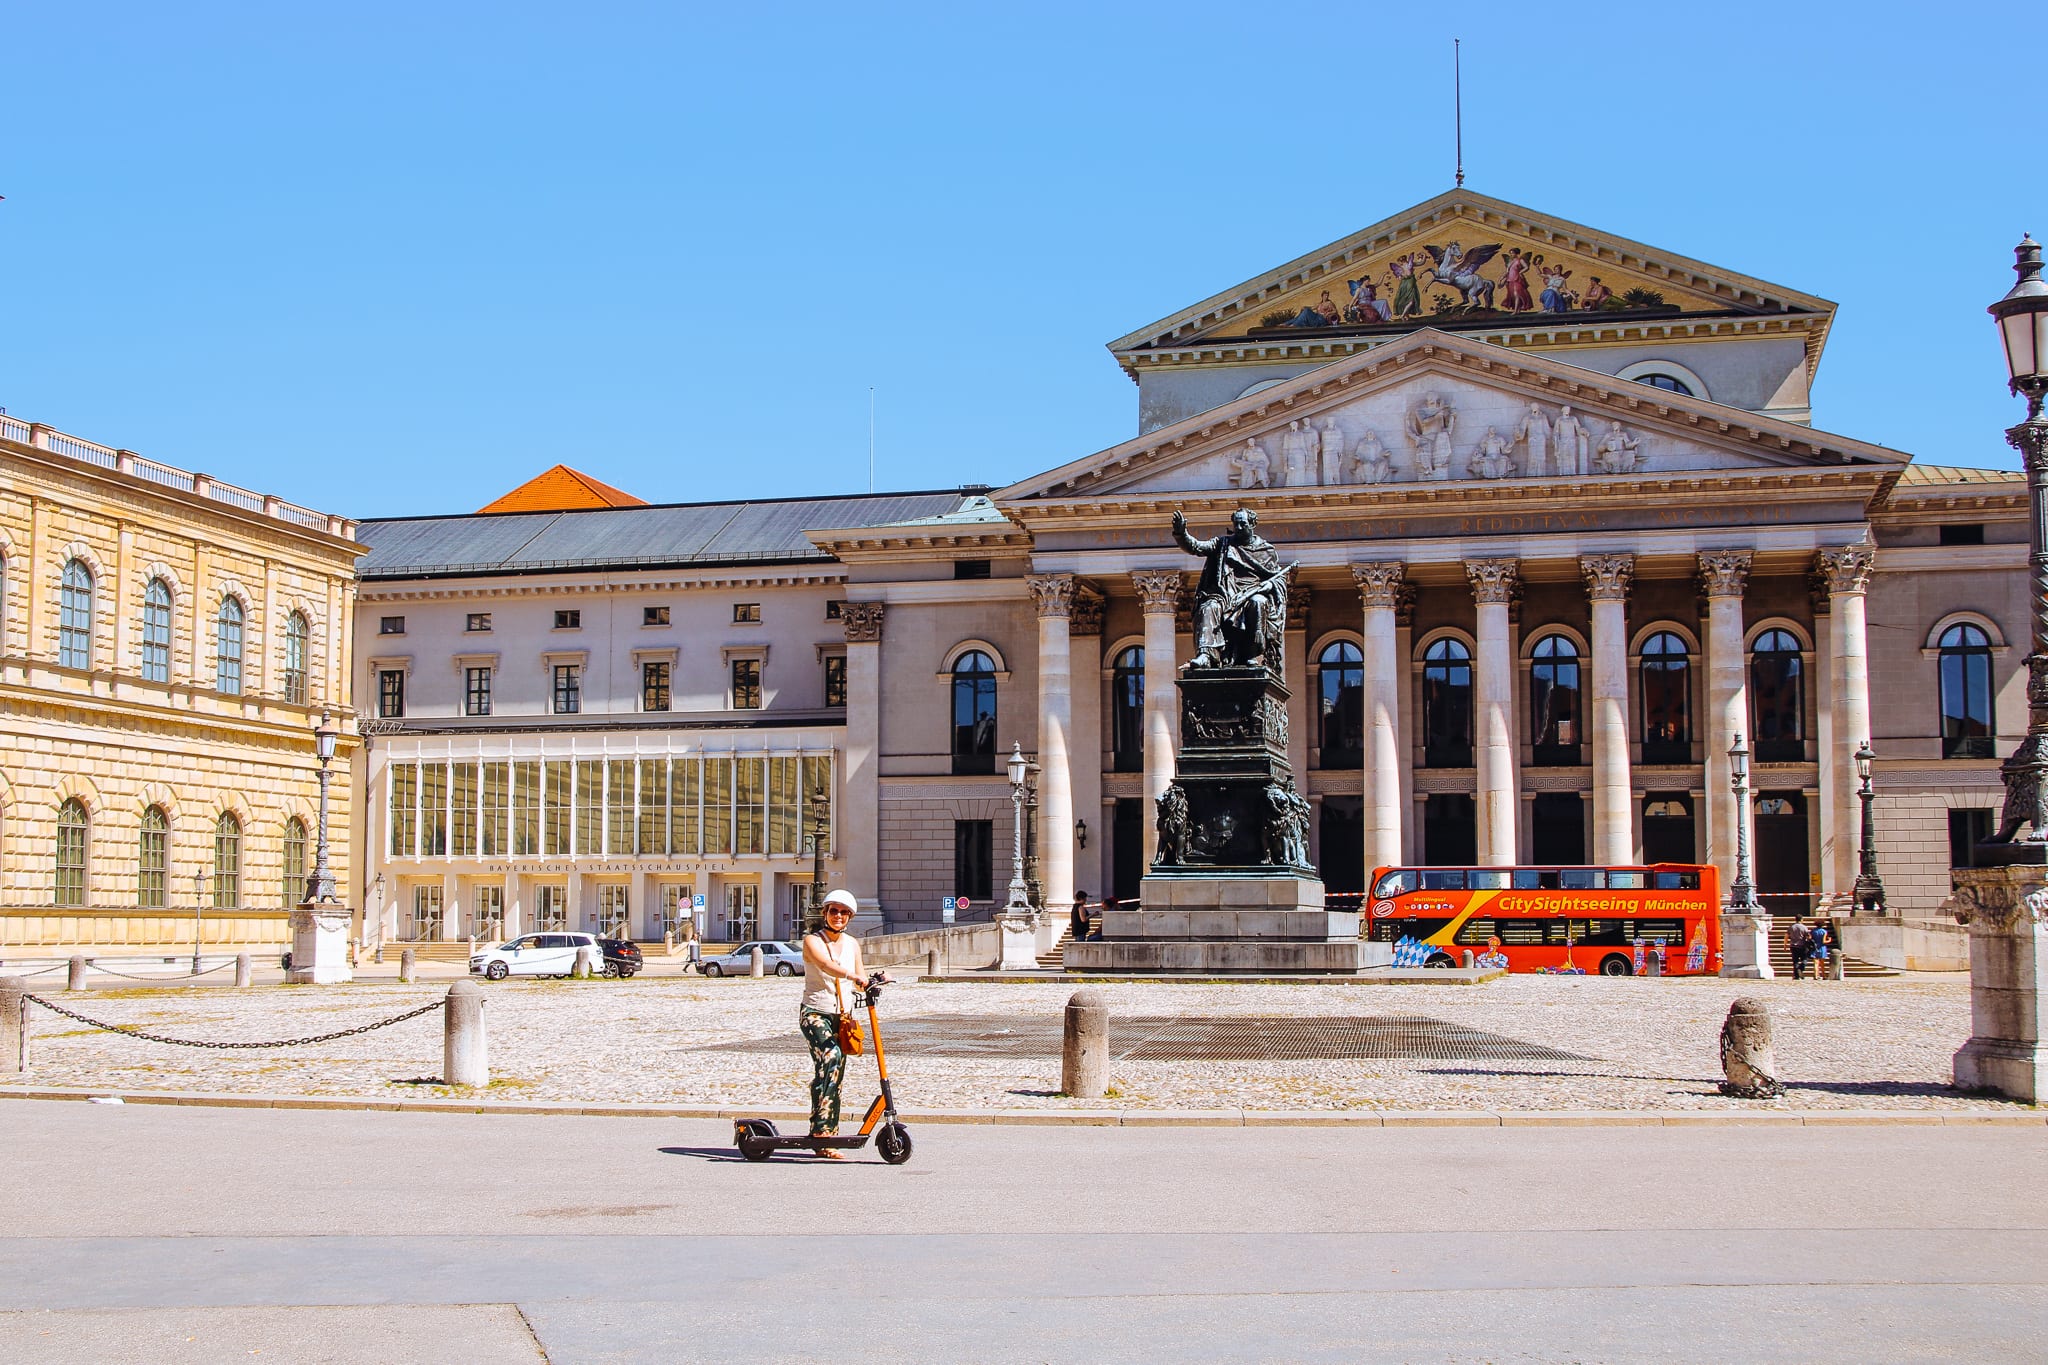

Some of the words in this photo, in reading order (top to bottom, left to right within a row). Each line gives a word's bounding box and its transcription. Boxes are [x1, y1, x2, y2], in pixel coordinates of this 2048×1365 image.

[1461, 513, 1601, 532] REDDITVM
[1656, 506, 1792, 524] MCMLXIII
[489, 863, 578, 872] BAYERISCHES
[589, 863, 726, 872] STAATSSCHAUSPIEL
[1498, 896, 1639, 913] CitySightseeing
[1644, 898, 1707, 910] München
